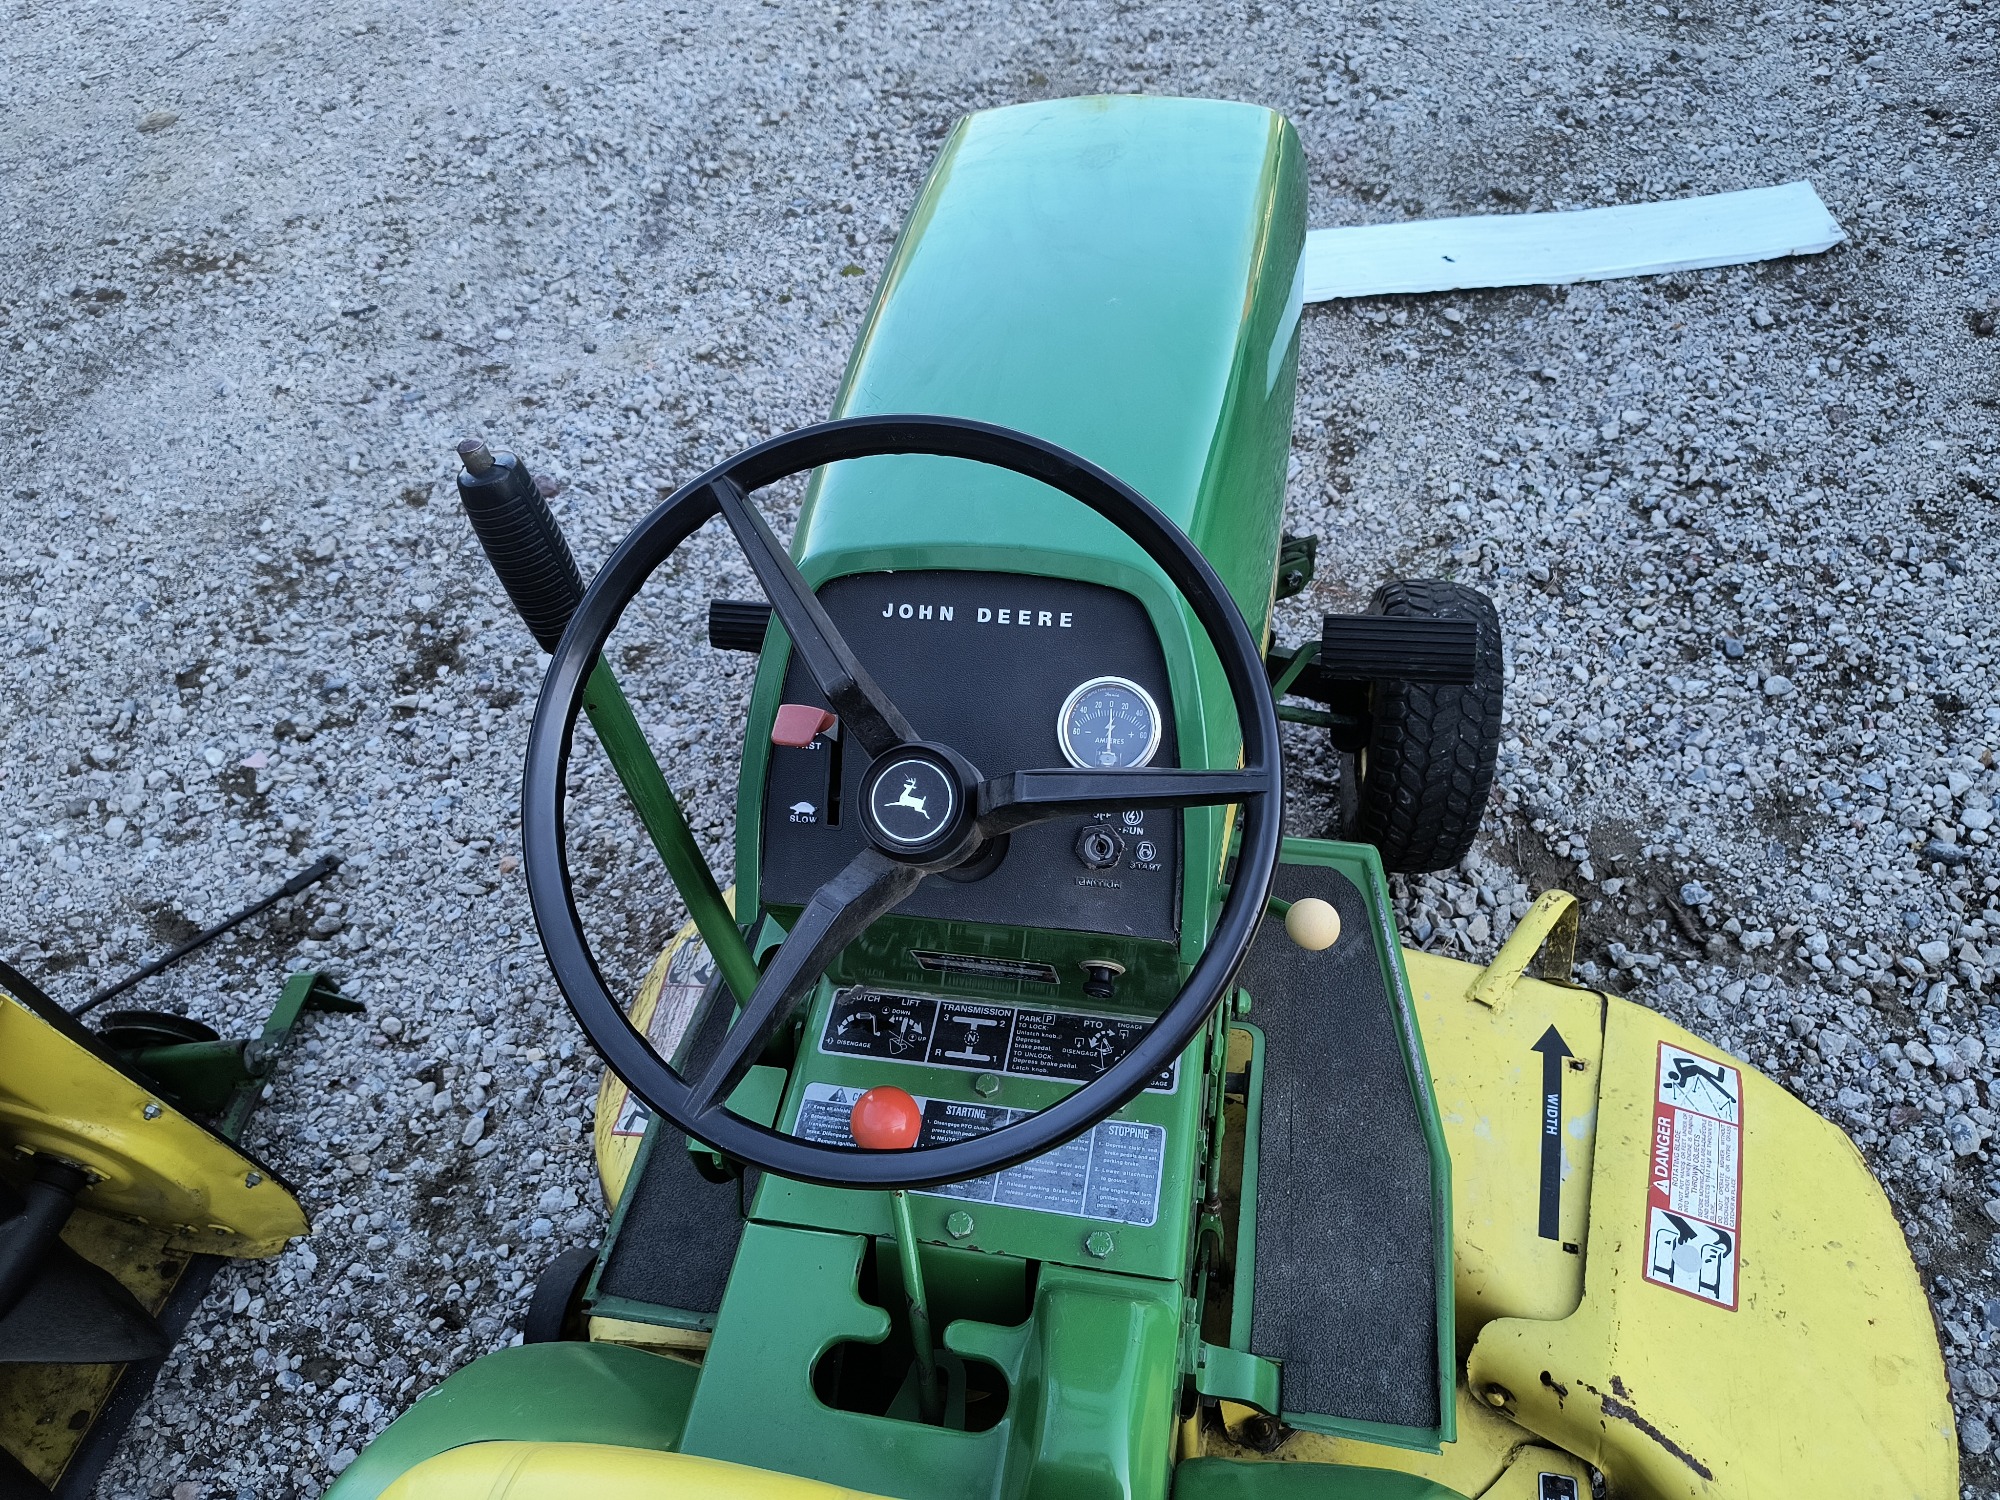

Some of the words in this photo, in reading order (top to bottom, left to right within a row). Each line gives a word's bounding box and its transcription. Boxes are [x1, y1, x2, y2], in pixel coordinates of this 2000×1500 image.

[882, 603, 954, 621] JOHN
[977, 608, 1073, 627] DEERE
[790, 815, 817, 823] SLOW
[1122, 827, 1143, 835] RUN
[1129, 861, 1162, 871] START
[902, 999, 921, 1007] LIFT
[892, 1008, 911, 1016] DOWN
[943, 1003, 1011, 1017] TRANSMISSION
[1083, 1020, 1103, 1029] PTO
[967, 1034, 976, 1042] N
[837, 1040, 871, 1048] DISENGAGE
[1062, 1048, 1098, 1057] DISENGAGE
[945, 1105, 986, 1119] STARTING
[1546, 1093, 1559, 1136] WIDTH
[934, 1120, 959, 1128] Disengage
[1108, 1125, 1149, 1139] STOPPING
[1654, 1116, 1671, 1178] DANGER
[1672, 1153, 1680, 1187] ROTATING
[1725, 1164, 1730, 1172] OR
[1678, 1203, 1683, 1211] DO
[1681, 1151, 1685, 1159] OR
